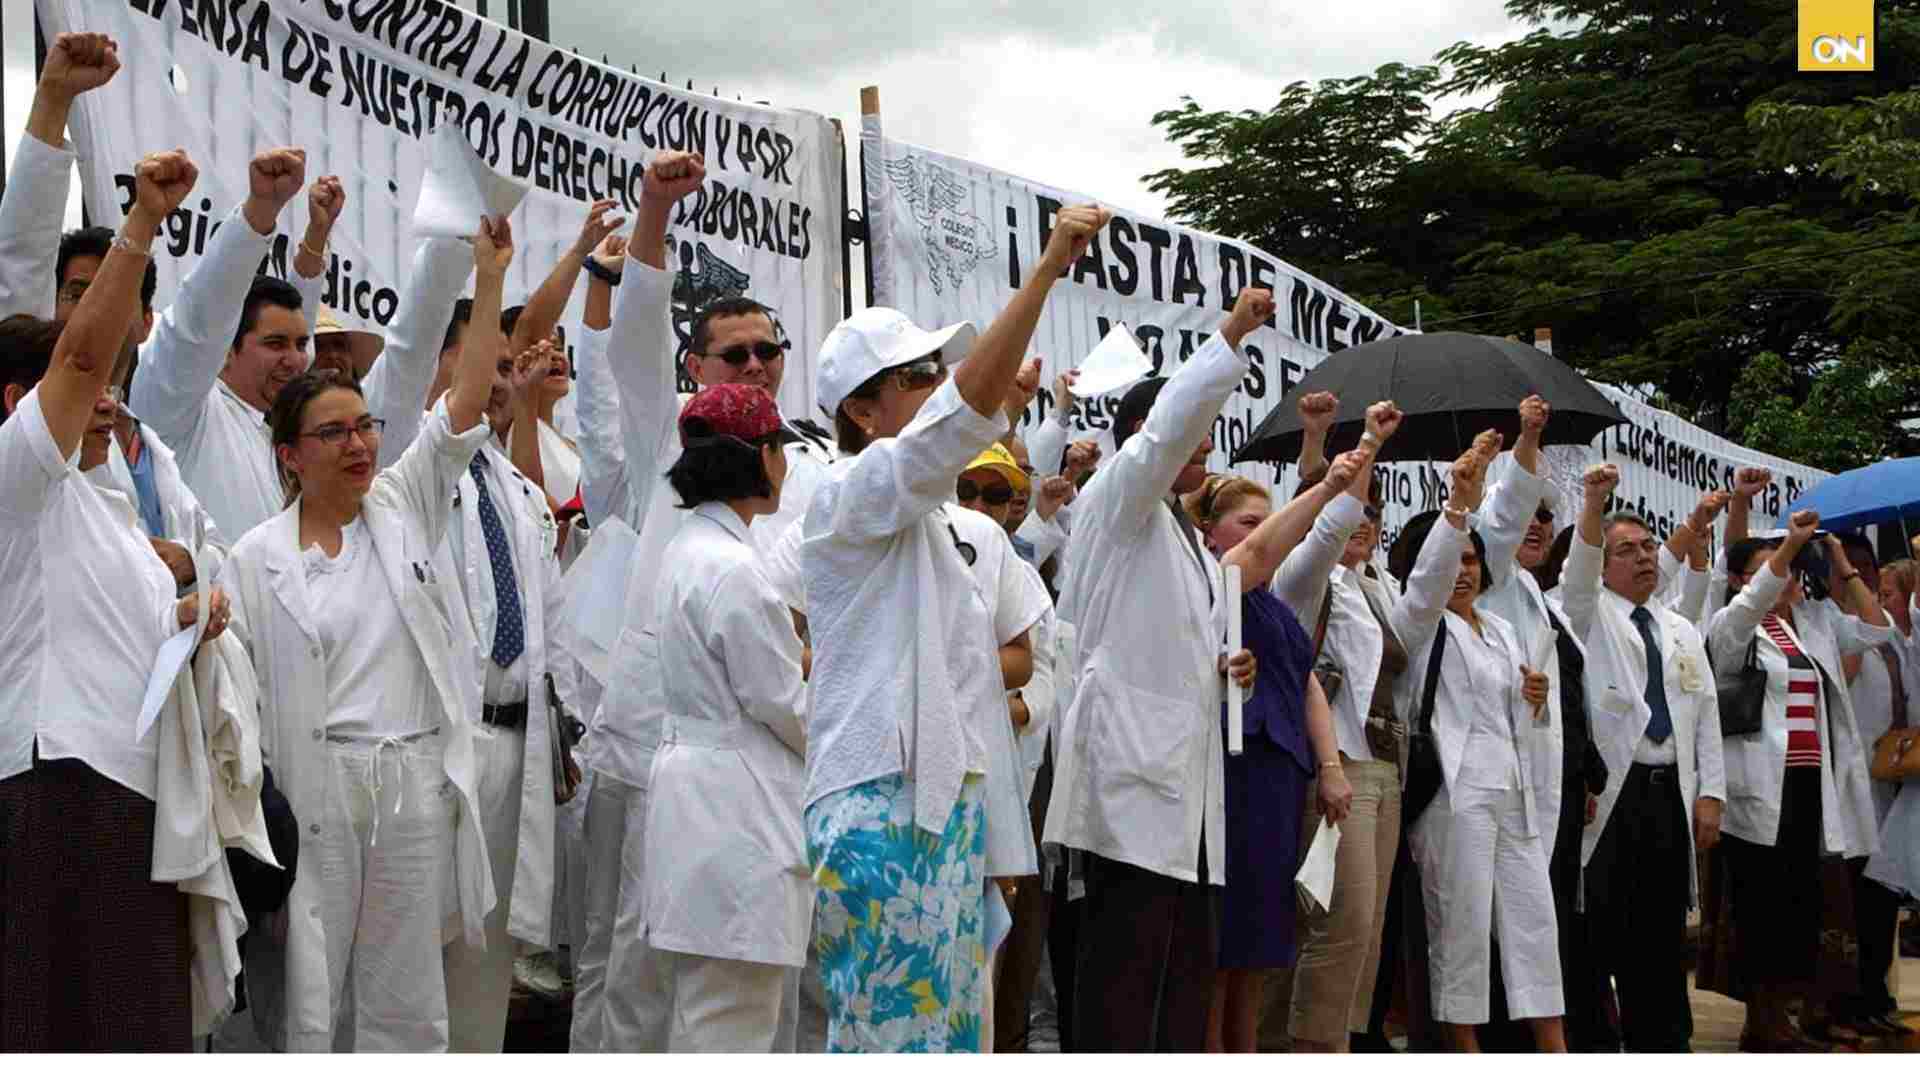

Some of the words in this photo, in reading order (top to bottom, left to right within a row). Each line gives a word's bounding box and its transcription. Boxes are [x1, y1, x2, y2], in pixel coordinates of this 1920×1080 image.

[281, 18, 334, 98] DE
[511, 117, 646, 213] DERECHO
[474, 29, 530, 98] LA
[527, 50, 708, 153] CORRUPCION
[714, 114, 731, 170] Y
[736, 122, 794, 186] POR
[1290, 277, 1403, 353] MEN
[1615, 421, 1719, 493] Luchemos
